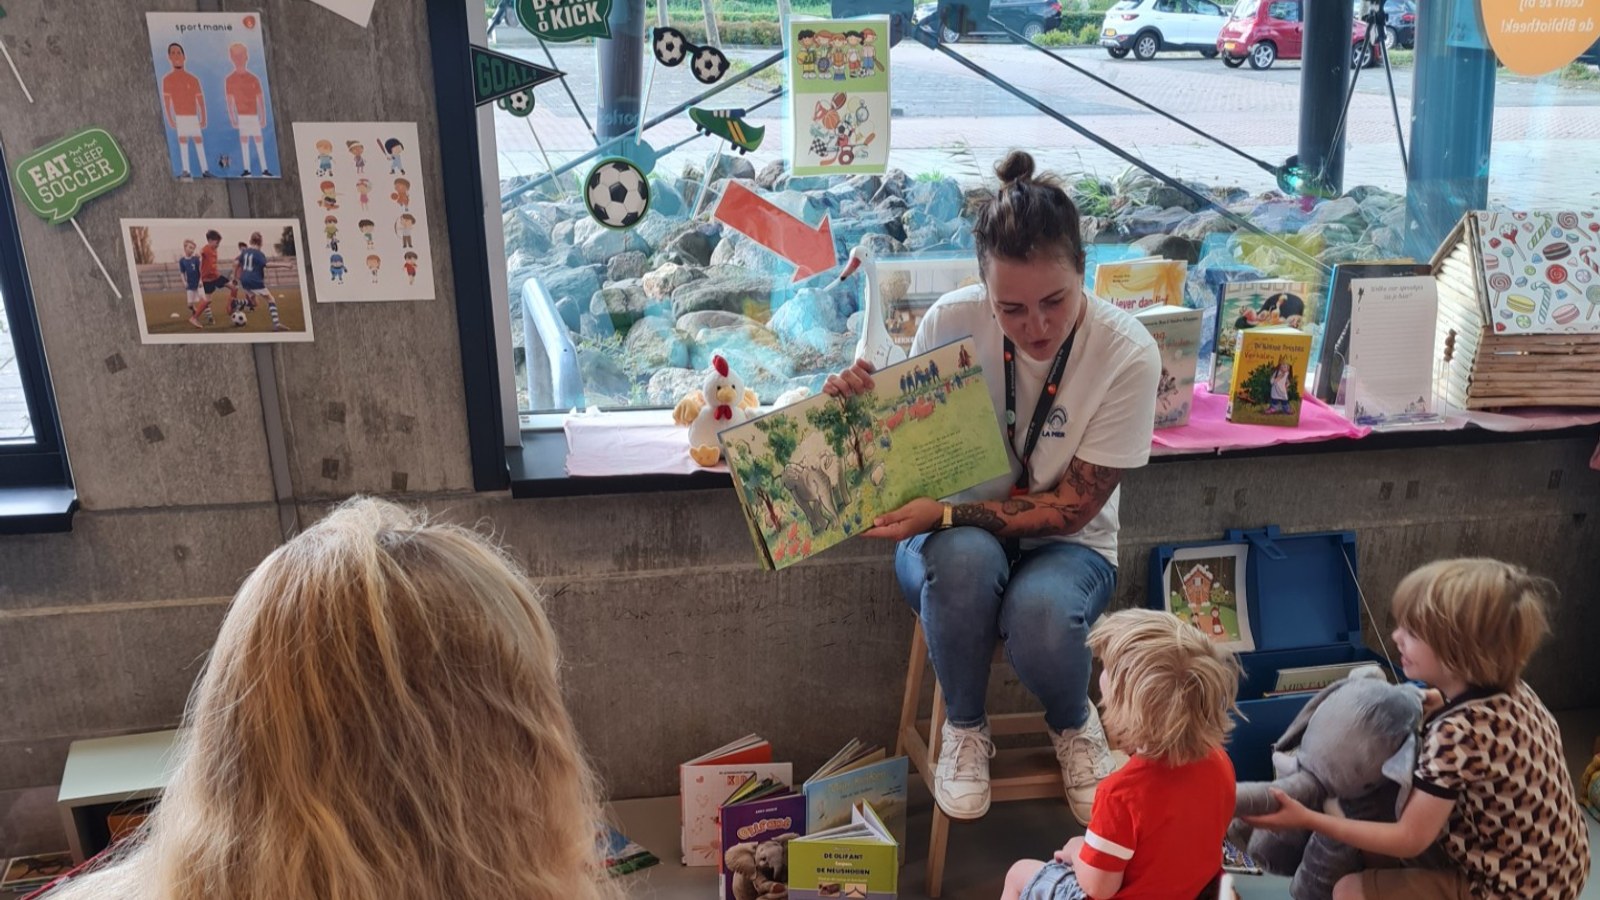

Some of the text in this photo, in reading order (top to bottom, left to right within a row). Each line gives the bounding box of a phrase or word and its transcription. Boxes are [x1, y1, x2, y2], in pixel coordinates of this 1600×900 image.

[175, 23, 233, 34] sportmanie
[549, 1, 603, 30] KICK
[476, 53, 537, 96] GOAL!
[27, 146, 103, 187] EAT SLEEP
[38, 158, 114, 203] SOCCER
[243, 252, 254, 272] 11
